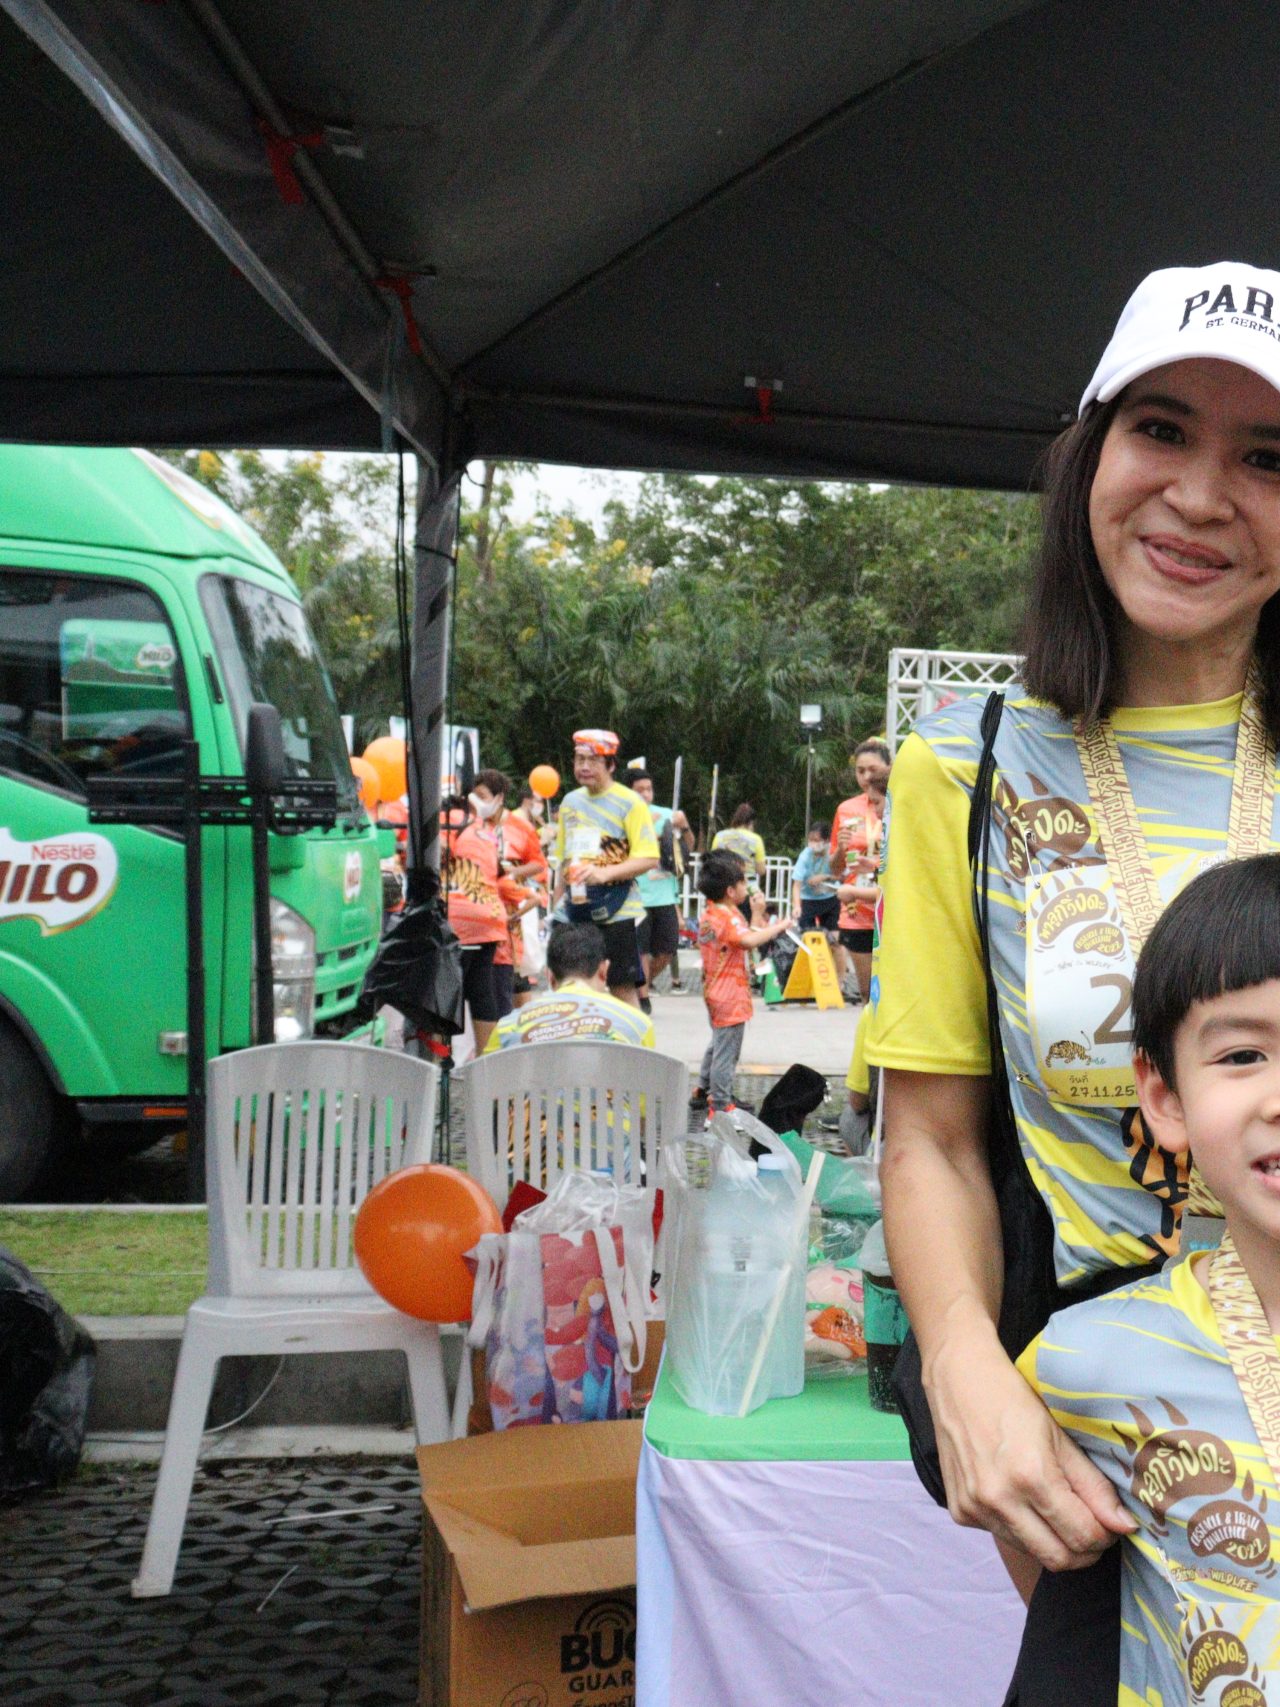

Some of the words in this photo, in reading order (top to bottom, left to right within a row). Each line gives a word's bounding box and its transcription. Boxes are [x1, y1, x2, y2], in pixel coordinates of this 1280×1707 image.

[1206, 317, 1224, 328] ST.
[1103, 792, 1132, 835] TRAIL
[1238, 761, 1266, 840] CHALLENGE
[1113, 831, 1153, 915] CHALLENGE
[1069, 1071, 1089, 1083] วันที่
[1225, 1538, 1267, 1560] 2022
